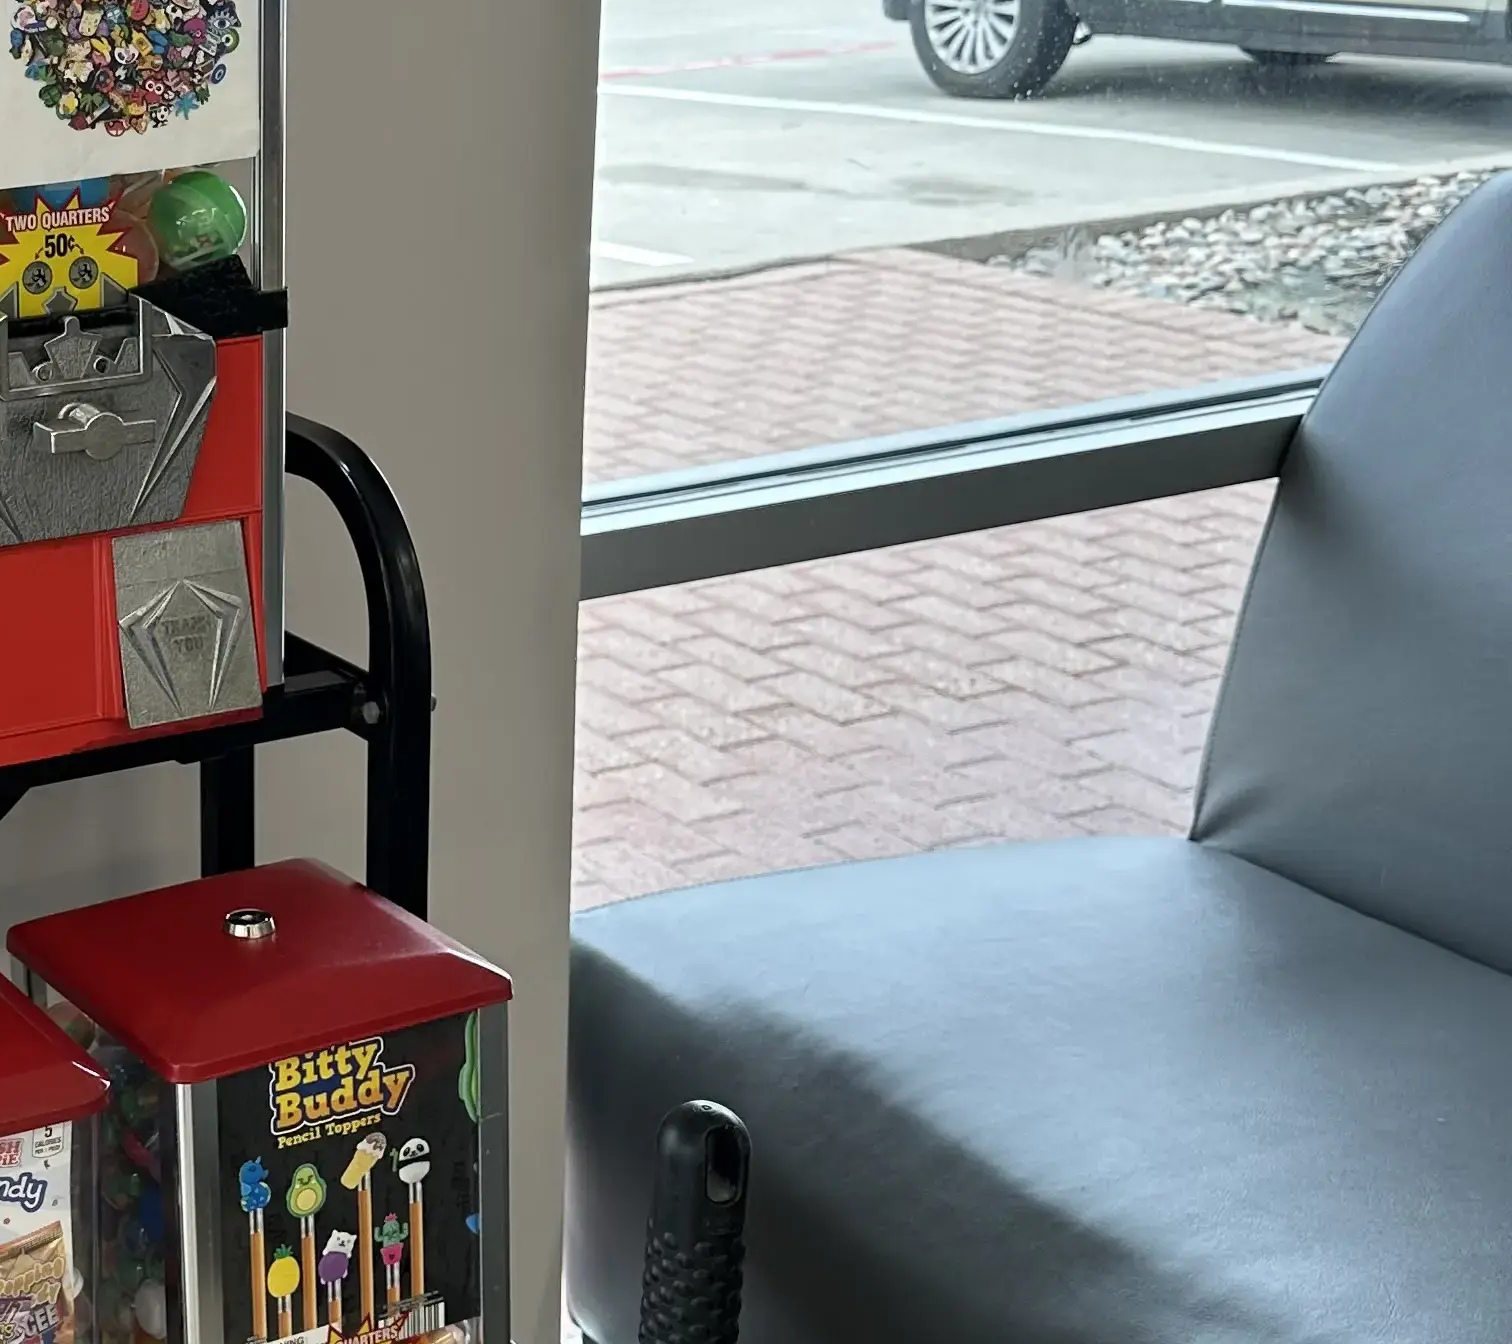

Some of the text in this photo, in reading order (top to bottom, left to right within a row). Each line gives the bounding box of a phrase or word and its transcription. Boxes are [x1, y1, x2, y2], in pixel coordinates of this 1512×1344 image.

[5, 206, 110, 232] TWO QUARTERS
[44, 233, 75, 258] 50¢
[274, 1043, 378, 1092] Bitty
[275, 1068, 410, 1129] Buddy
[277, 1112, 381, 1149] Pencil Toppers
